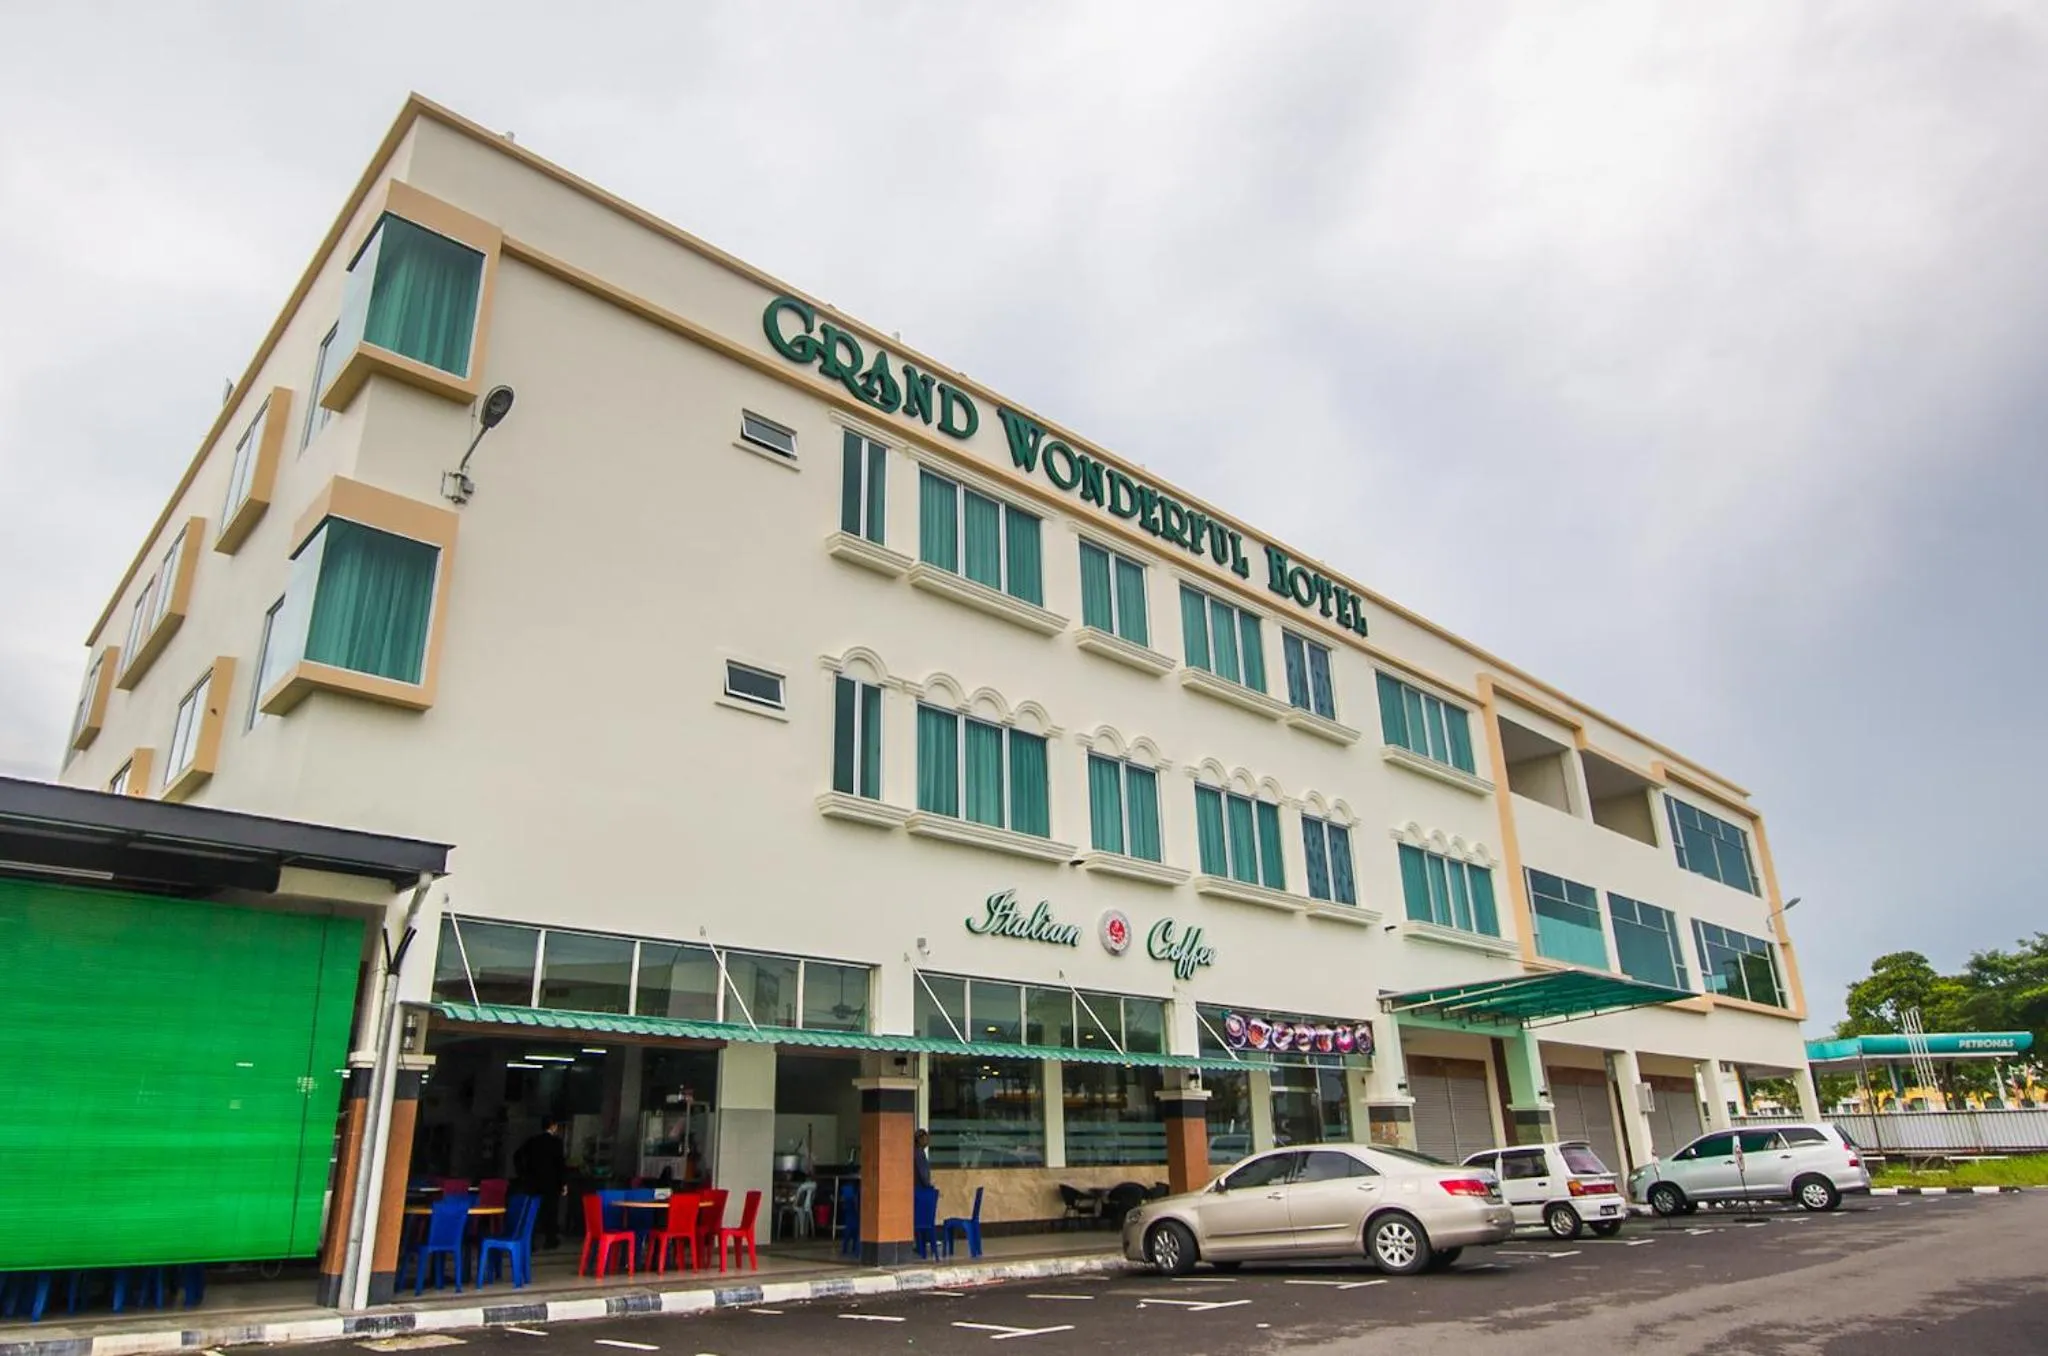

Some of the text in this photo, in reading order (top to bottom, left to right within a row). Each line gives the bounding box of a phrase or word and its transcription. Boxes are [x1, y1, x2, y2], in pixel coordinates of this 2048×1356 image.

[762, 293, 1368, 637] GRAND WONDERFUL HOTEL
[965, 888, 1217, 980] Italian Coffee
[1958, 1038, 2015, 1049] PETRONAS
